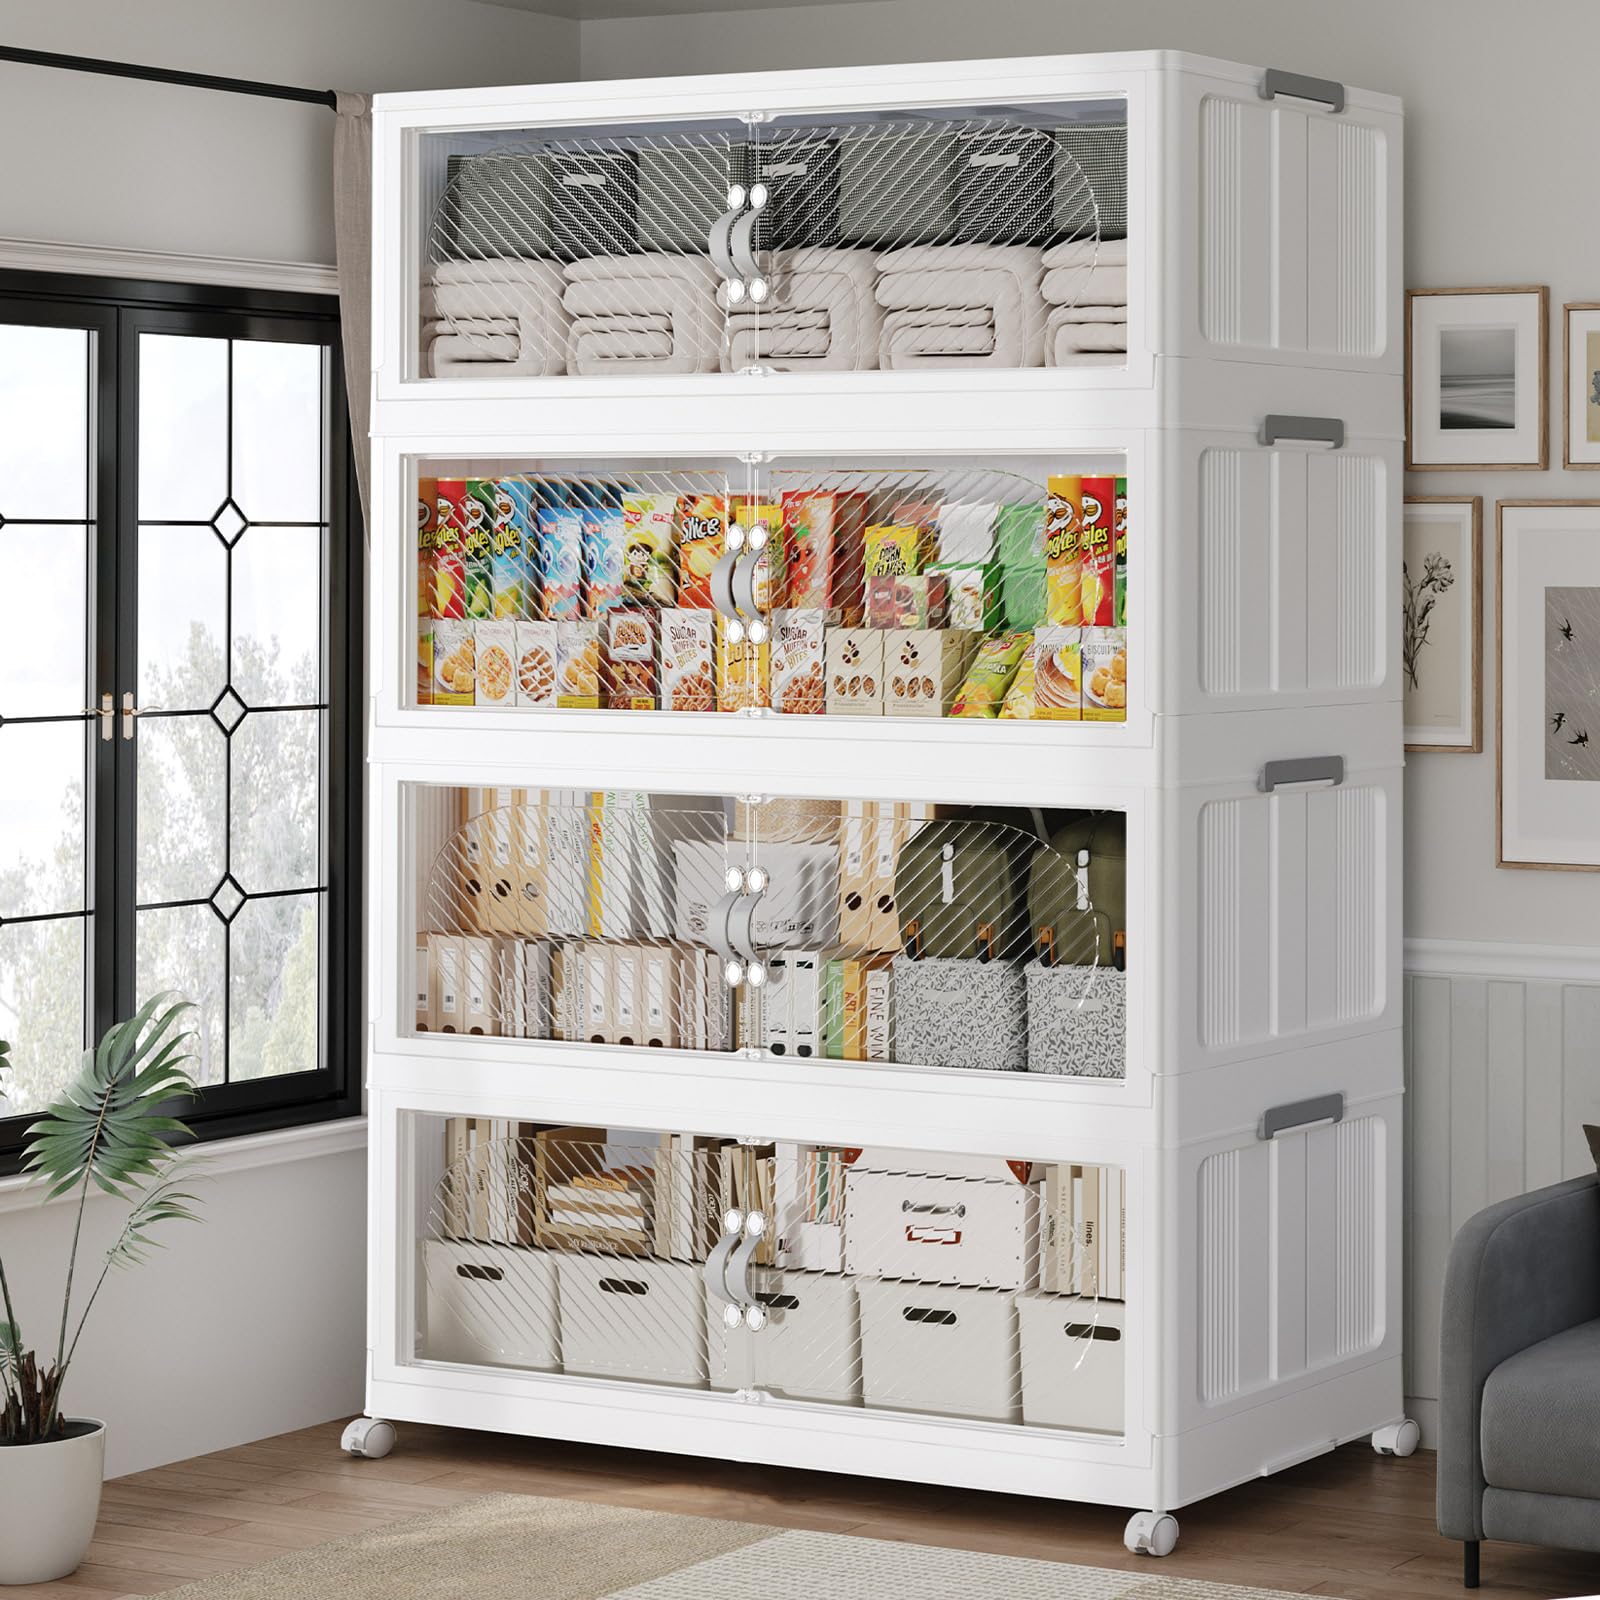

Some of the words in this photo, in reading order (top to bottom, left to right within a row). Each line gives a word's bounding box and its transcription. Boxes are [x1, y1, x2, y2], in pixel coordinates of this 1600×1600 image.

[845, 991, 857, 1013] ART
[870, 987, 885, 1021] FINE
[1085, 1221, 1094, 1247] lines.
